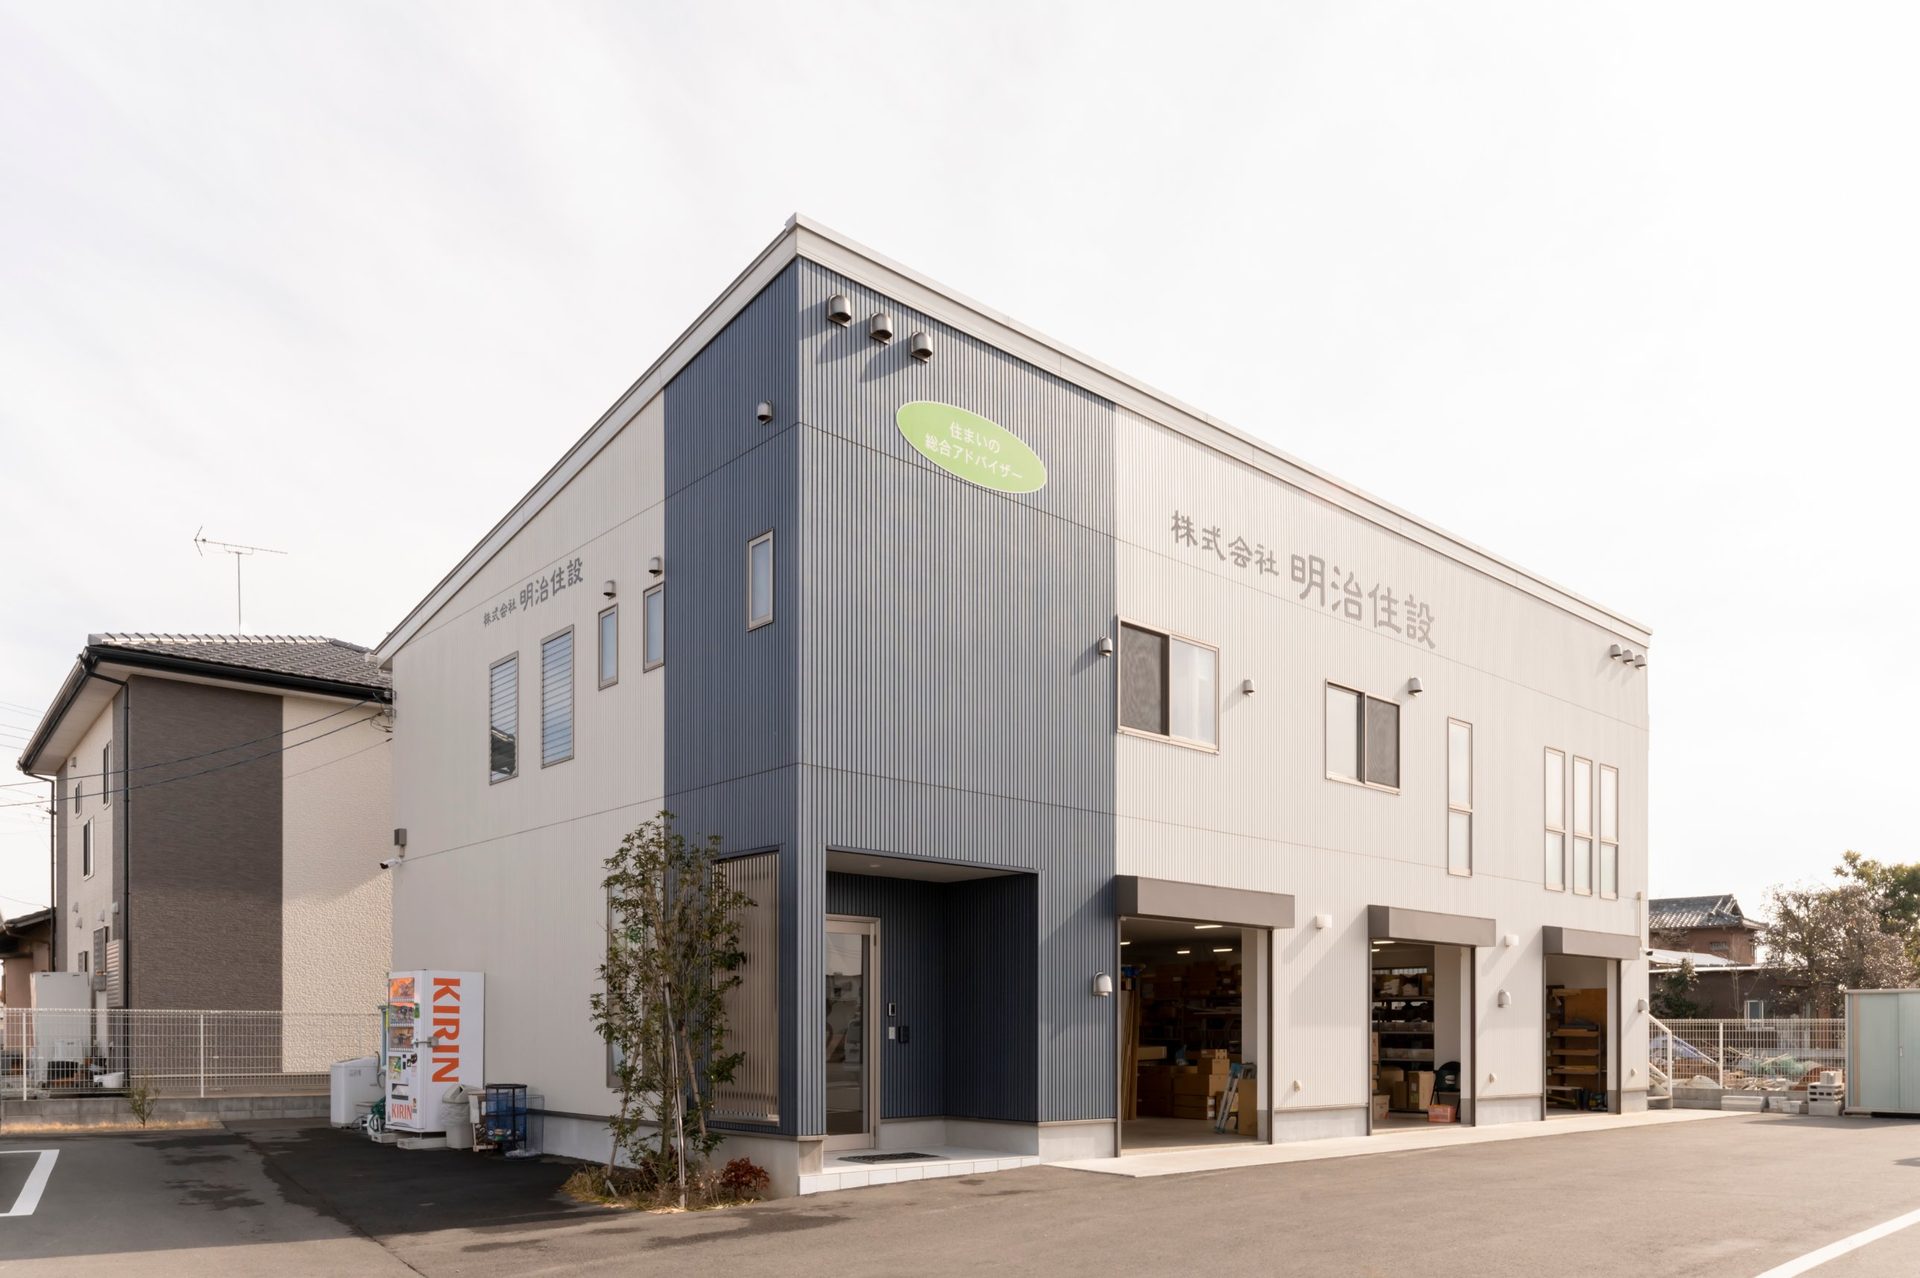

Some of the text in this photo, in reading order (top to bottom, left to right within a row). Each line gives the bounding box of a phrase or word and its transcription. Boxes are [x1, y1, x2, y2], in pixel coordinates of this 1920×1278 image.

[925, 432, 1024, 479] 総合アドバイザー
[950, 421, 1001, 454] 住まいの
[483, 557, 584, 628] 株式会社 明治住設
[1171, 510, 1437, 650] 株式会社 明治住設
[431, 977, 461, 1083] KIRIN
[391, 1103, 414, 1120] KIRIN
